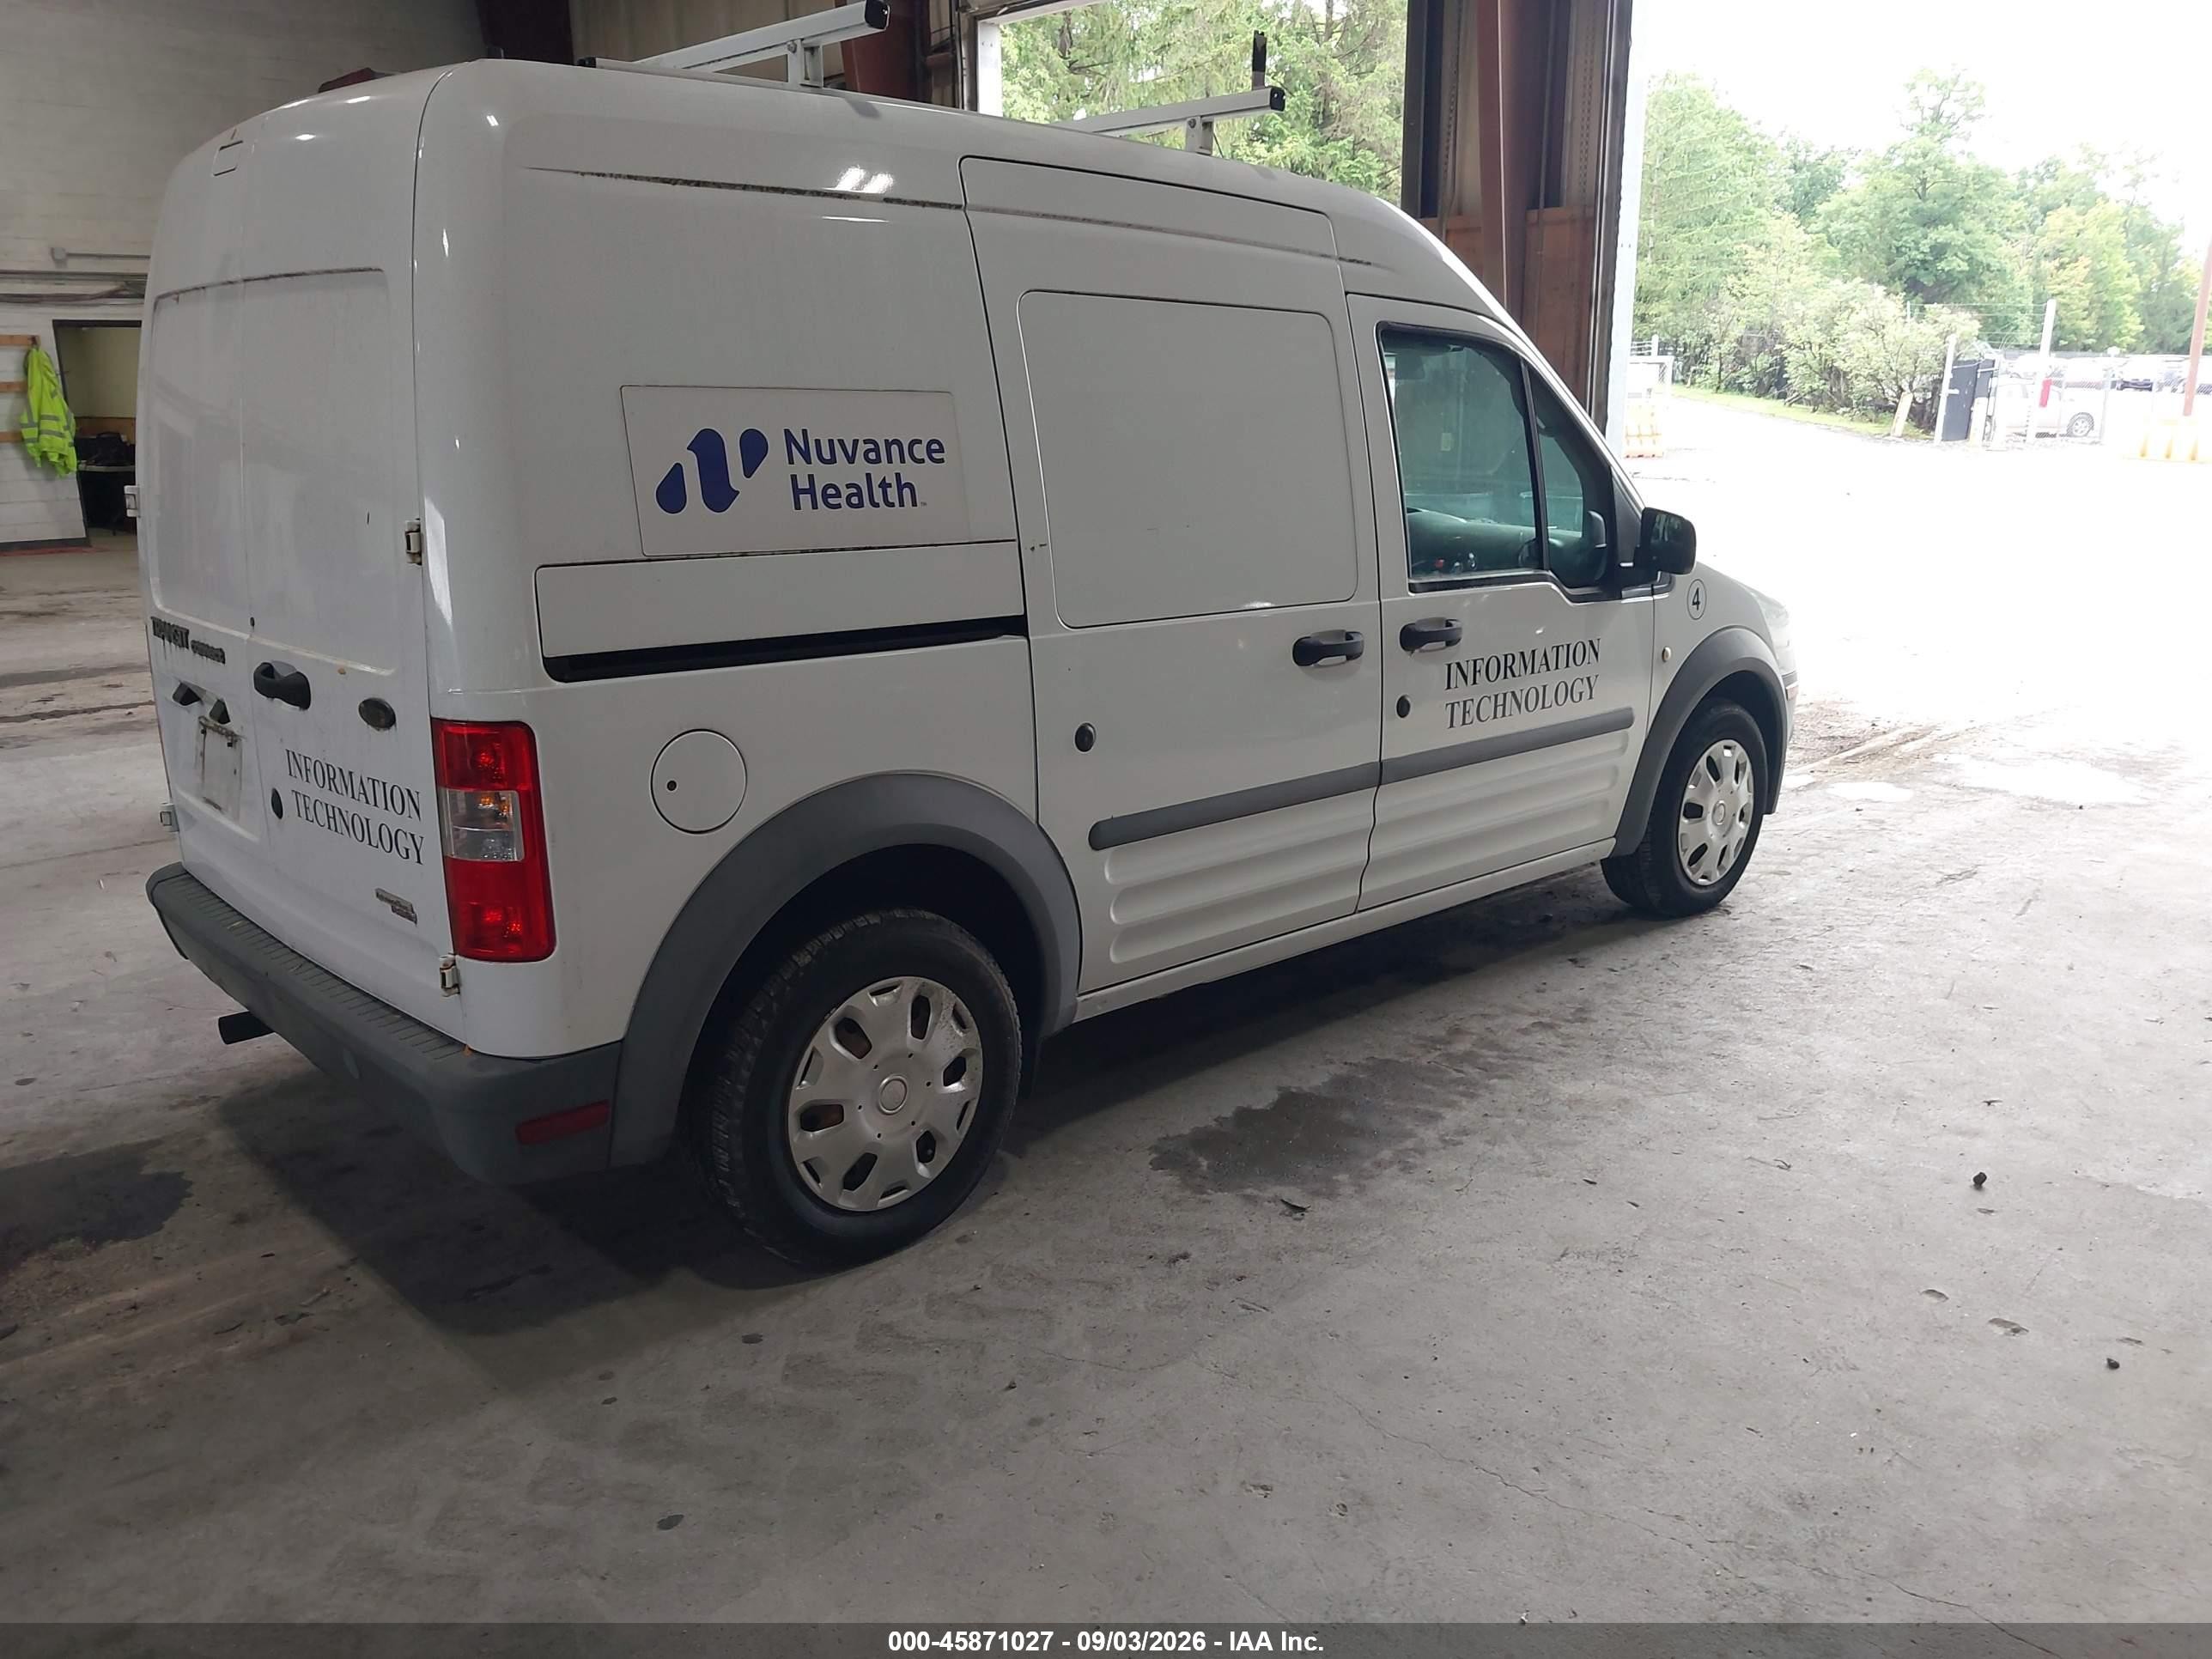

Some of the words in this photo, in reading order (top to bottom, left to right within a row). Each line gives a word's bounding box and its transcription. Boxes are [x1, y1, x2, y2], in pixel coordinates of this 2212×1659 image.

[784, 428, 945, 465] Nuvance
[790, 472, 918, 511] Health
[1690, 586, 1701, 611] 4
[1444, 638, 1601, 690] INFORMATION
[1445, 674, 1600, 729] TECHNOLOGY
[285, 748, 422, 822] INFORMATION
[291, 789, 424, 866] TECHNOLOGY
